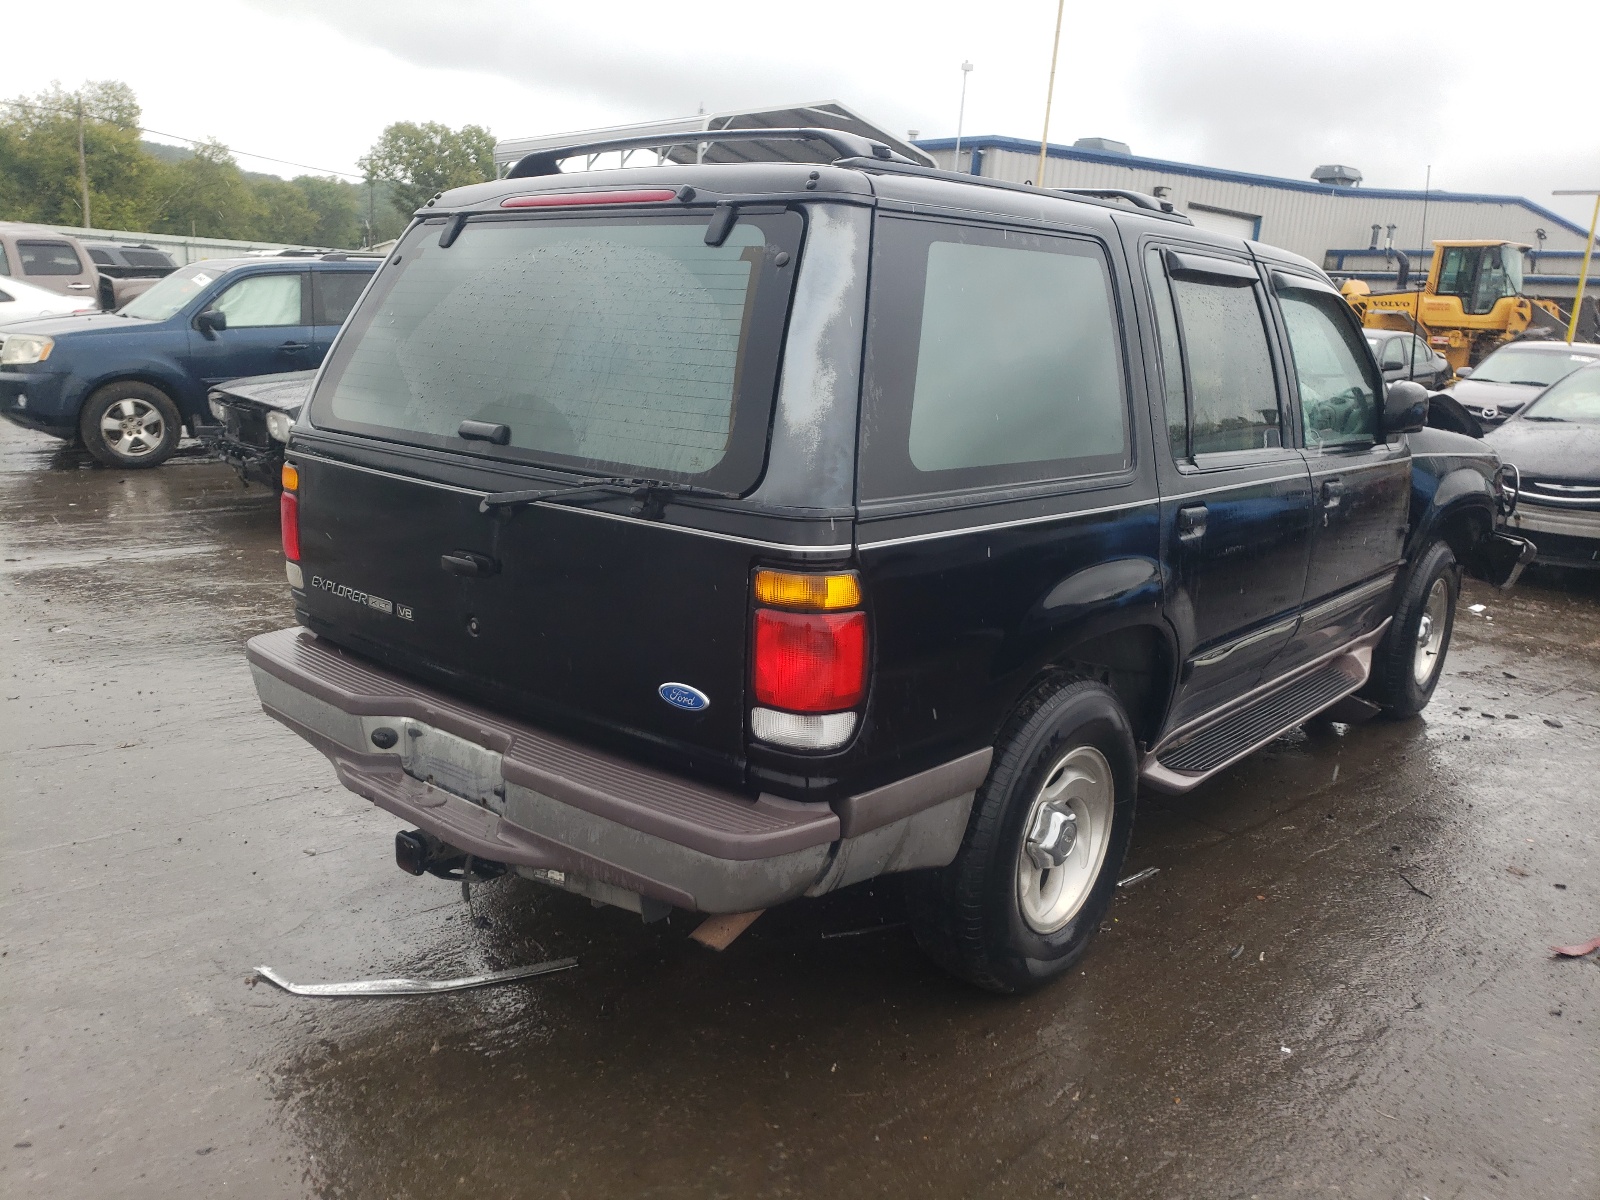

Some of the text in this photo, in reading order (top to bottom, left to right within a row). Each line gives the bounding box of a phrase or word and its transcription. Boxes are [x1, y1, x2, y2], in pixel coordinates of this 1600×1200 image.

[1372, 300, 1410, 308] VOLVO
[311, 575, 368, 605] EXPLORER
[398, 606, 412, 619] V8
[669, 687, 696, 706] Ford
